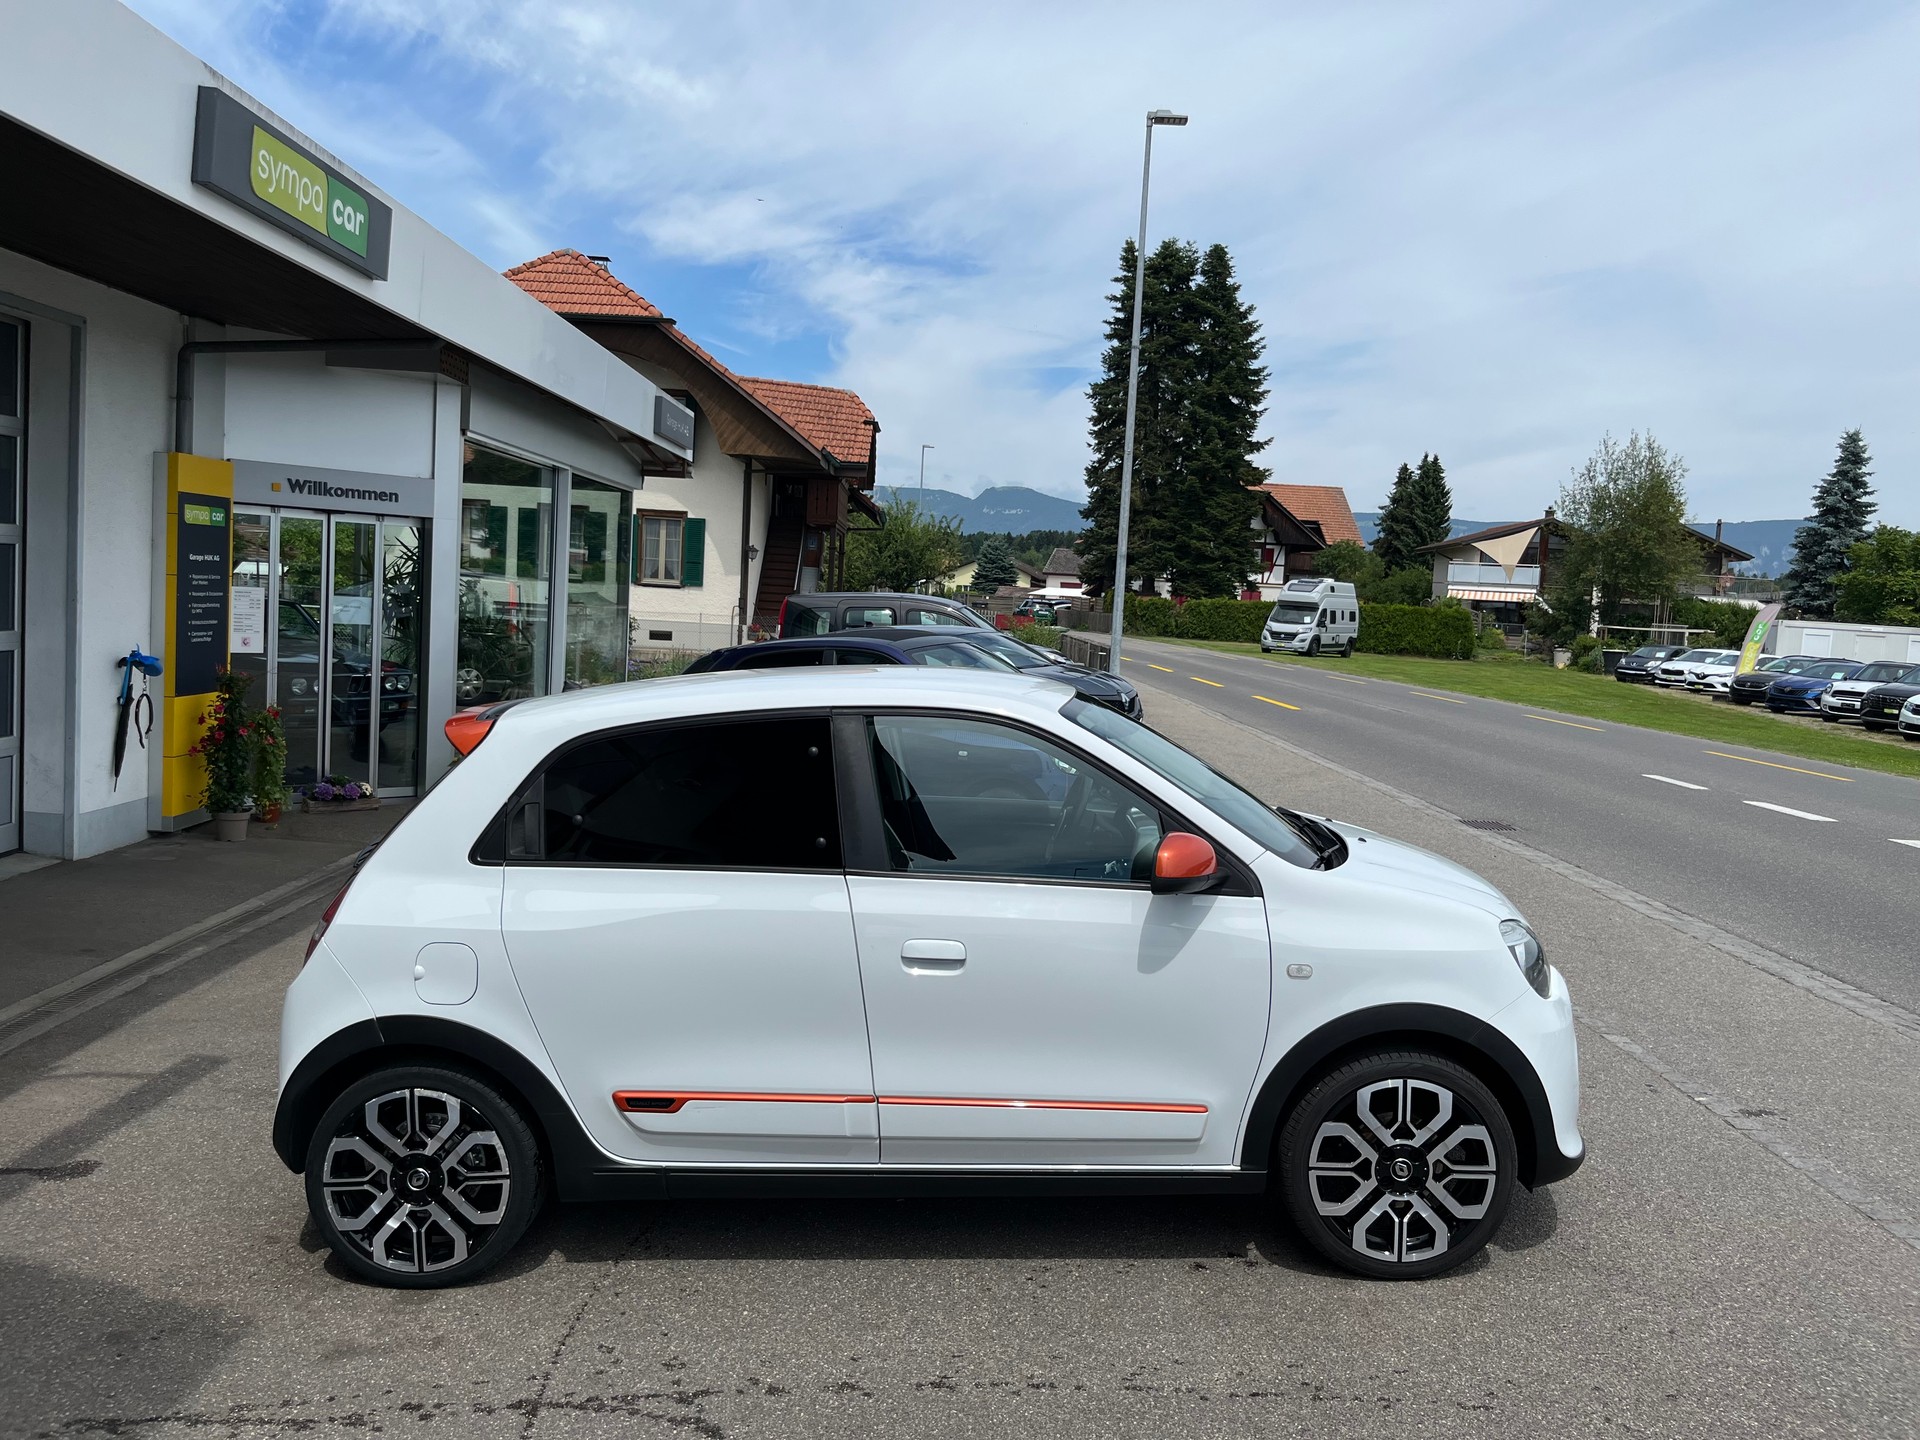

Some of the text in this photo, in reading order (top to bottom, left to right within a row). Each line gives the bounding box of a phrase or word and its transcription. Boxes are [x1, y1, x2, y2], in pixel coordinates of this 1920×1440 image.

[258, 149, 364, 236] sympa car
[287, 477, 400, 503] Willkommen
[186, 509, 224, 521] sympa car
[189, 553, 204, 562] Garage
[1753, 623, 1763, 641] car
[1743, 644, 1756, 673] ympa
